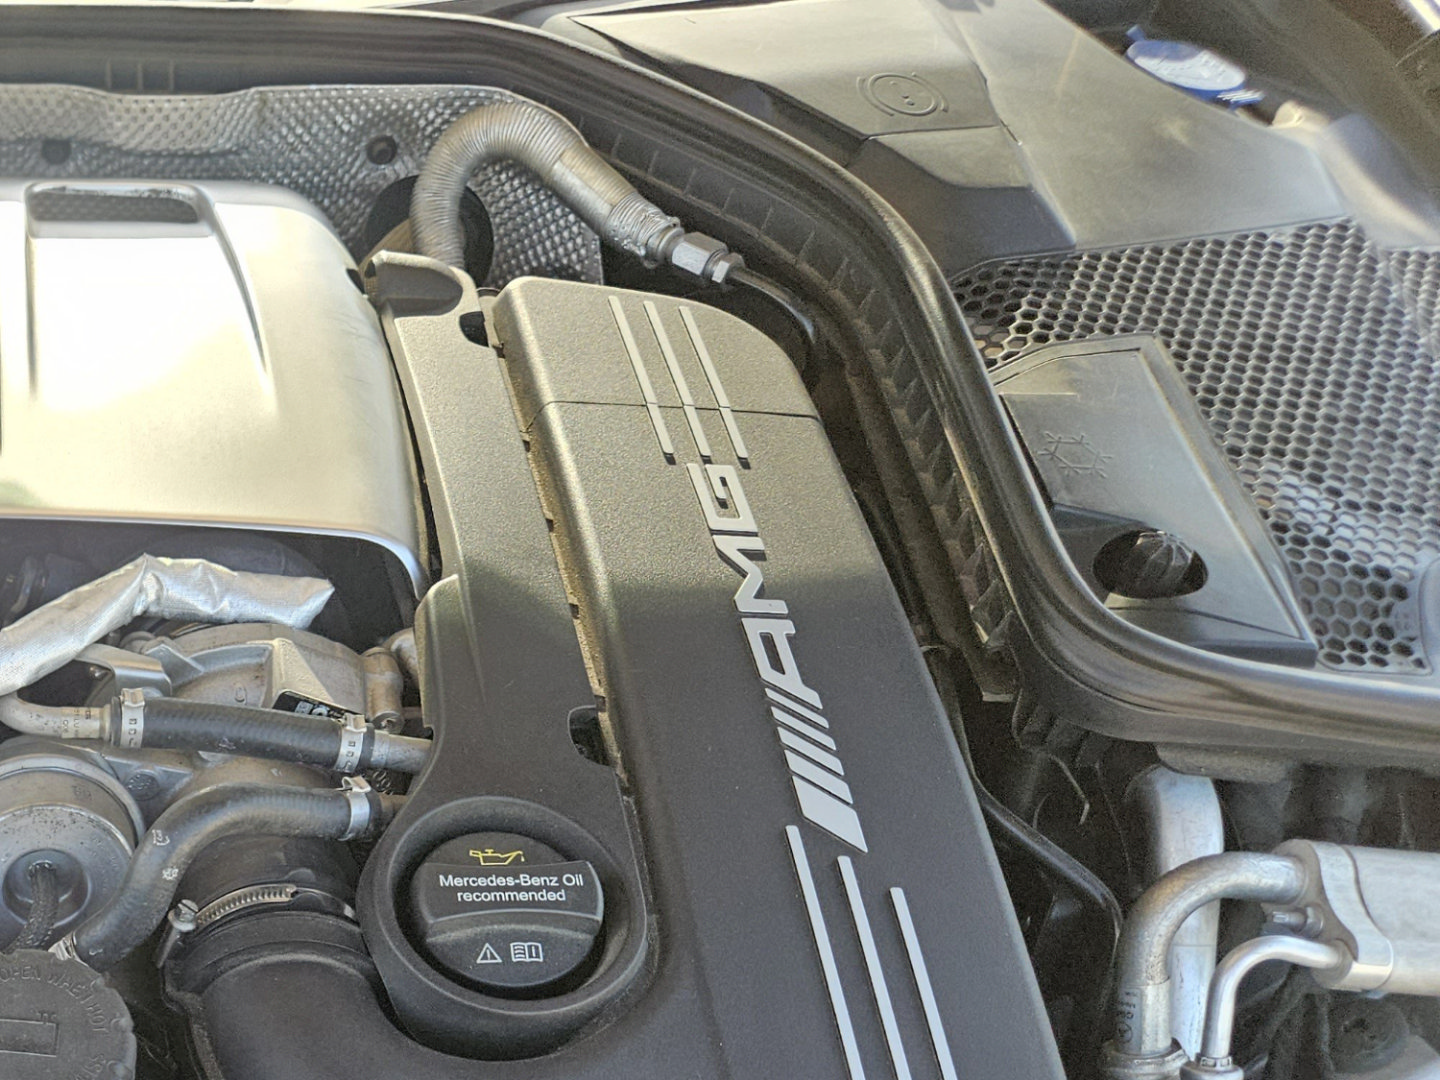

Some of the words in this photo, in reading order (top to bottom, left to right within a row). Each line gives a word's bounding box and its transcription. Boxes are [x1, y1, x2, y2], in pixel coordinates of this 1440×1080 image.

[686, 463, 823, 710] AMG
[439, 874, 559, 887] Mercedes-Benz
[562, 874, 584, 887] Oil
[457, 889, 566, 902] recommended
